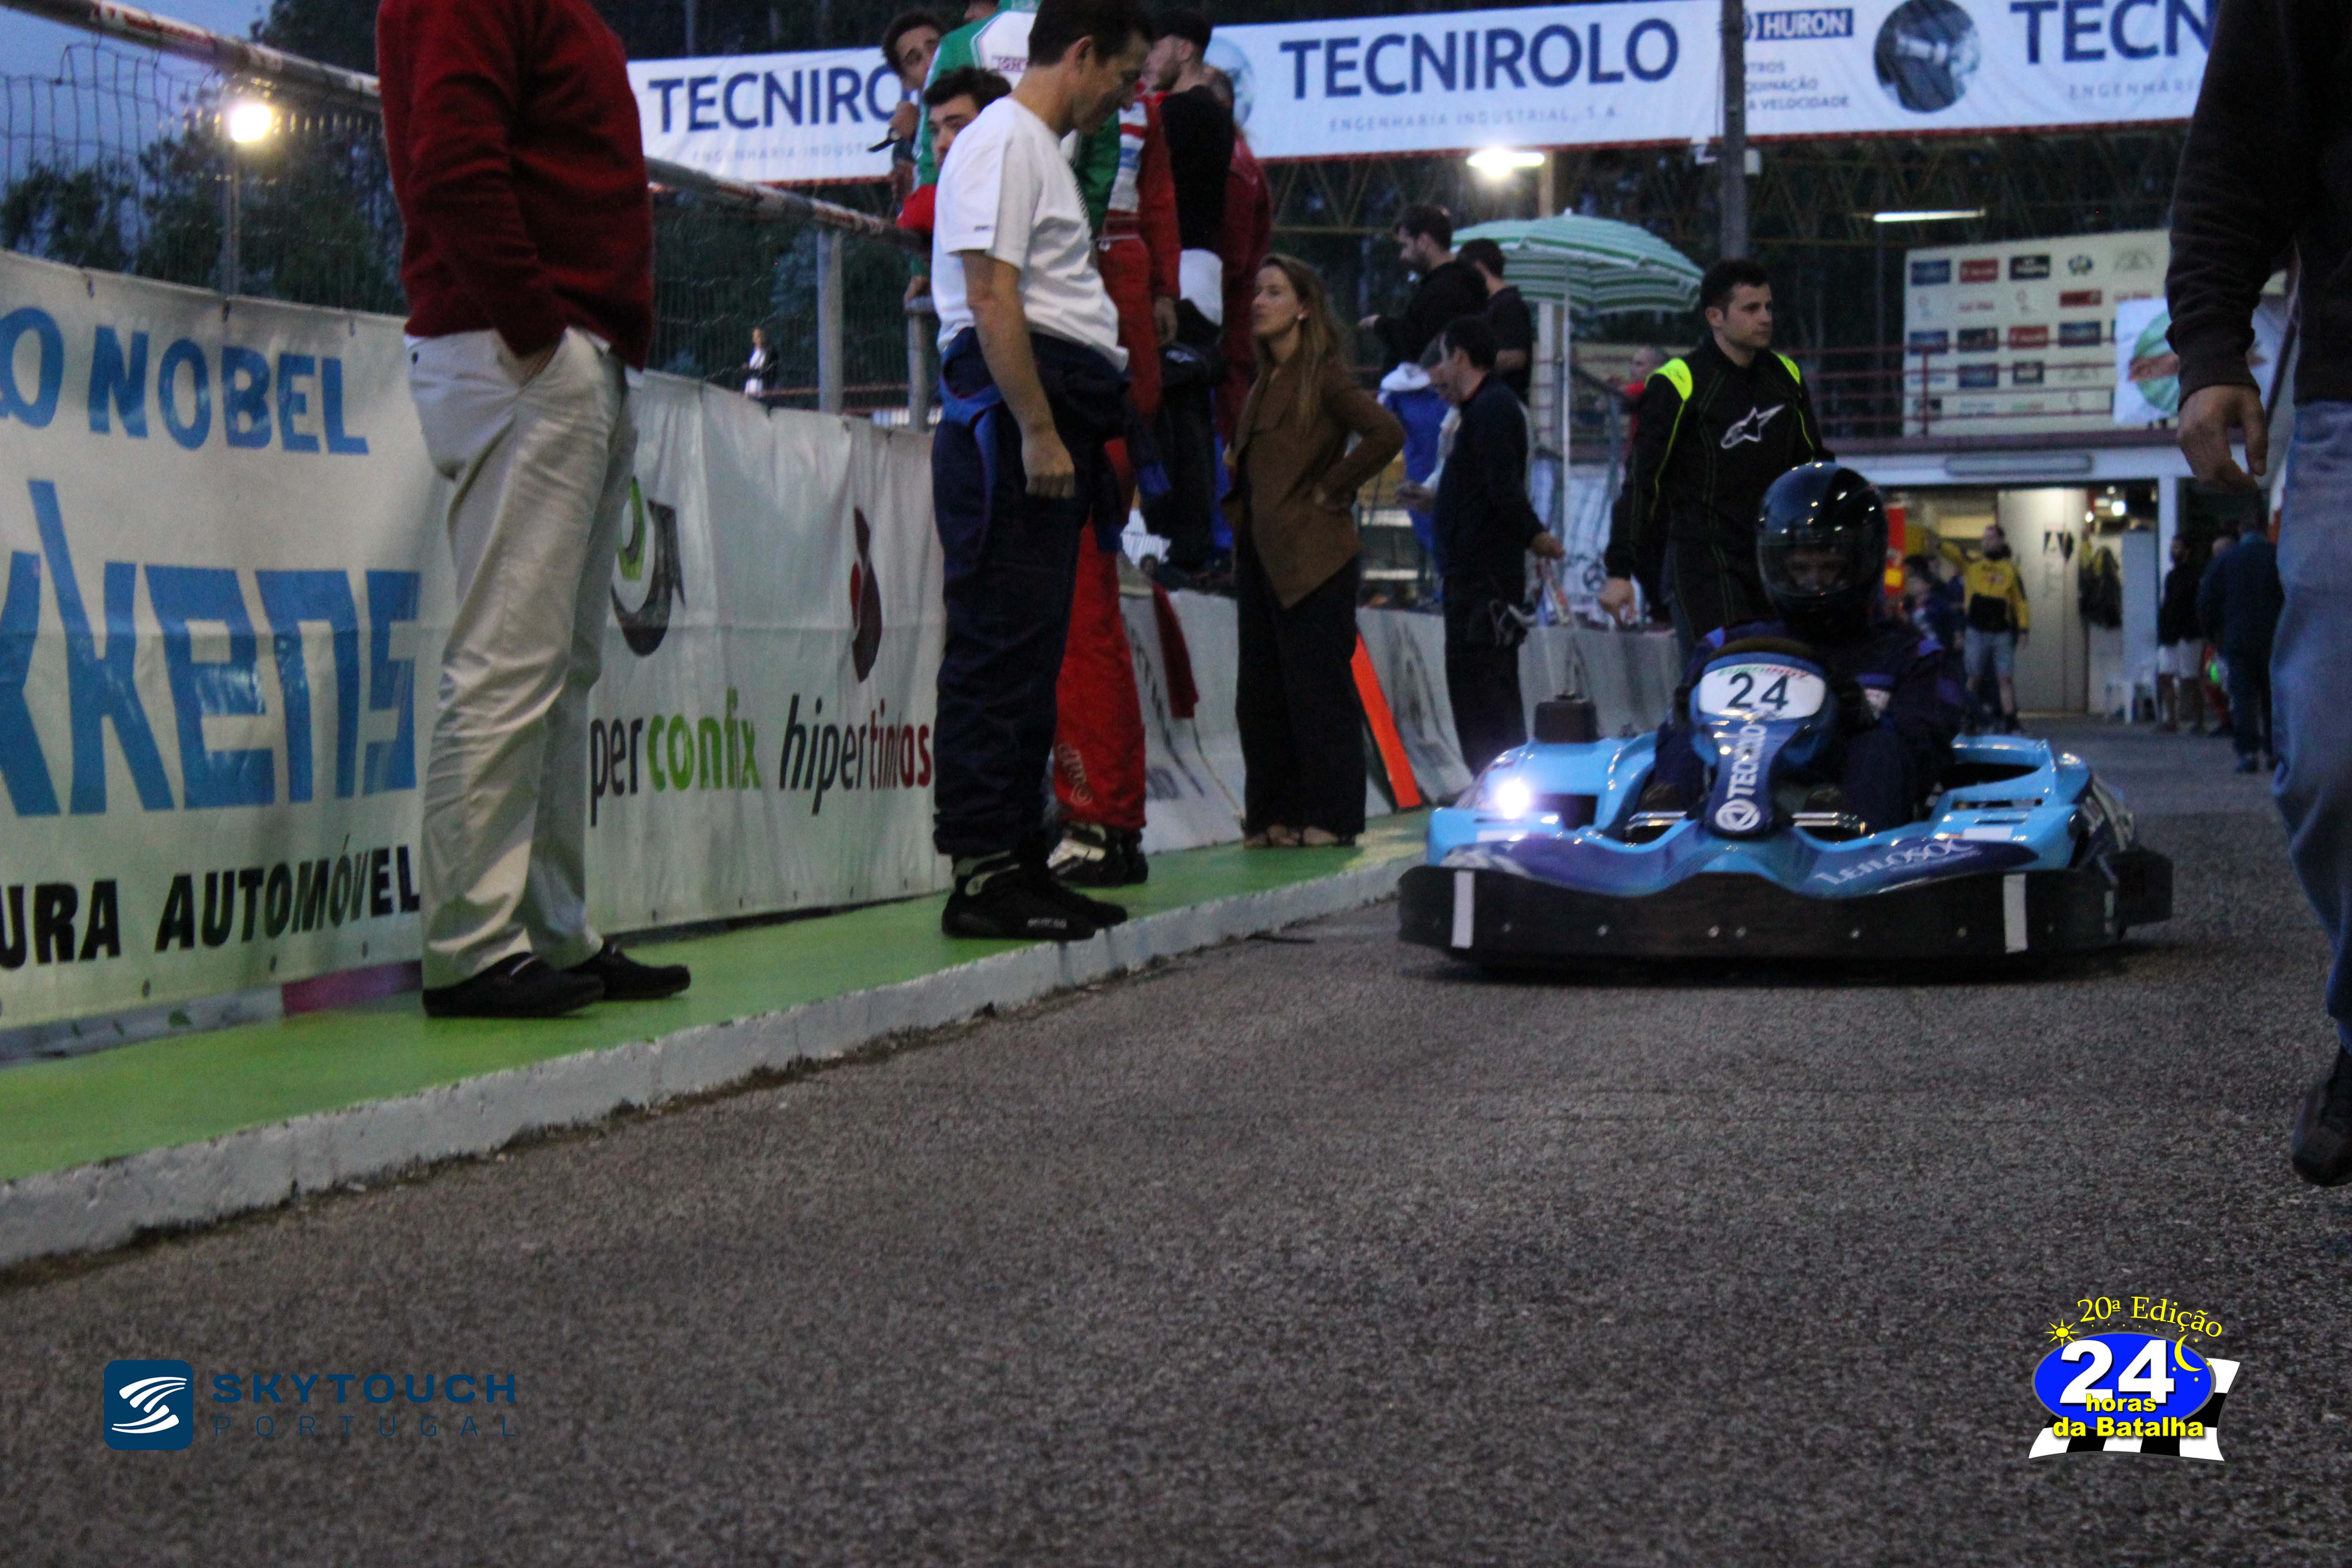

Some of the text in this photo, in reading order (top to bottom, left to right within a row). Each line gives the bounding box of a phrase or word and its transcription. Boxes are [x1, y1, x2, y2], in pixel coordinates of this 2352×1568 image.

[1763, 10, 1847, 37] HURON
[1279, 18, 1678, 100] TECNIROLO
[1329, 114, 1447, 132] ENGENHARIA
[88, 325, 369, 455] NOBEL
[1727, 672, 1788, 710] 24
[155, 834, 420, 952] AUTOMÓVEL
